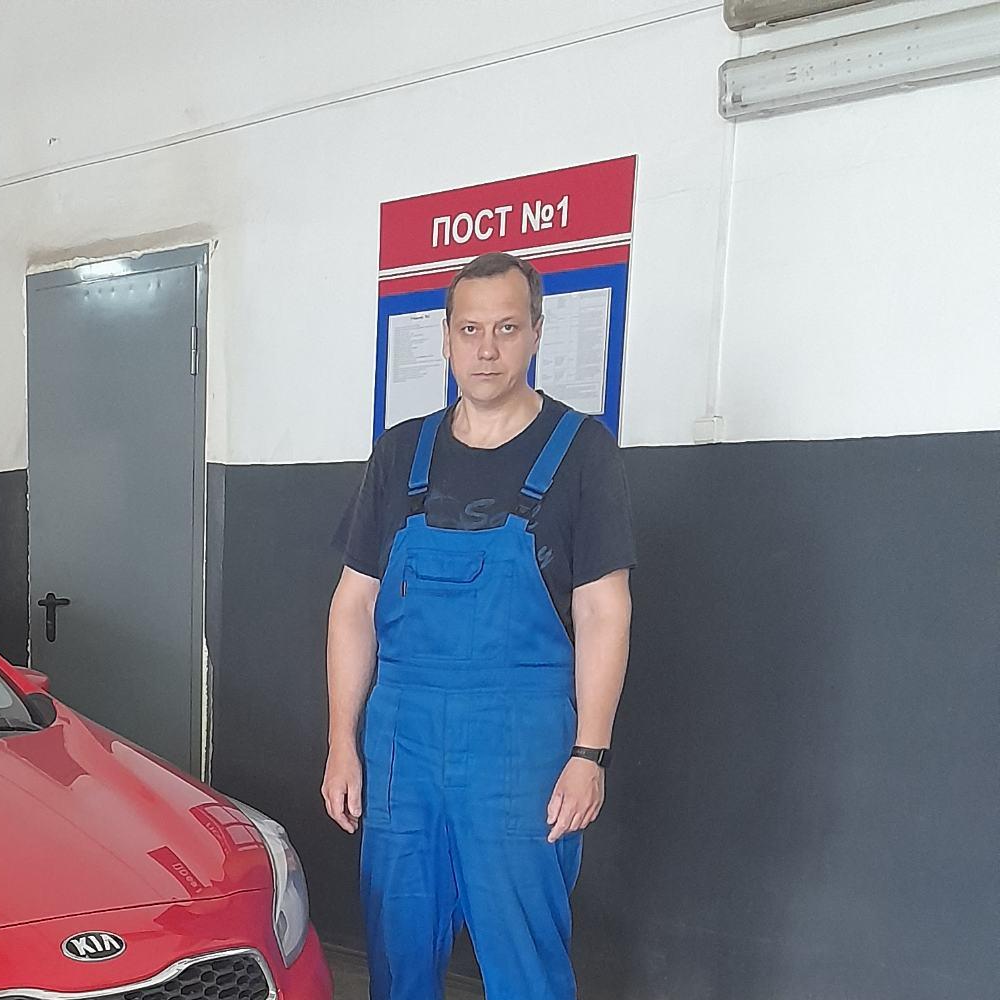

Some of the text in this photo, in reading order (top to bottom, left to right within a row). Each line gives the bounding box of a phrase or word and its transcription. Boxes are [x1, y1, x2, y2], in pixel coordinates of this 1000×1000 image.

[432, 195, 569, 248] ПОСТ №1
[70, 934, 121, 956] KIA
